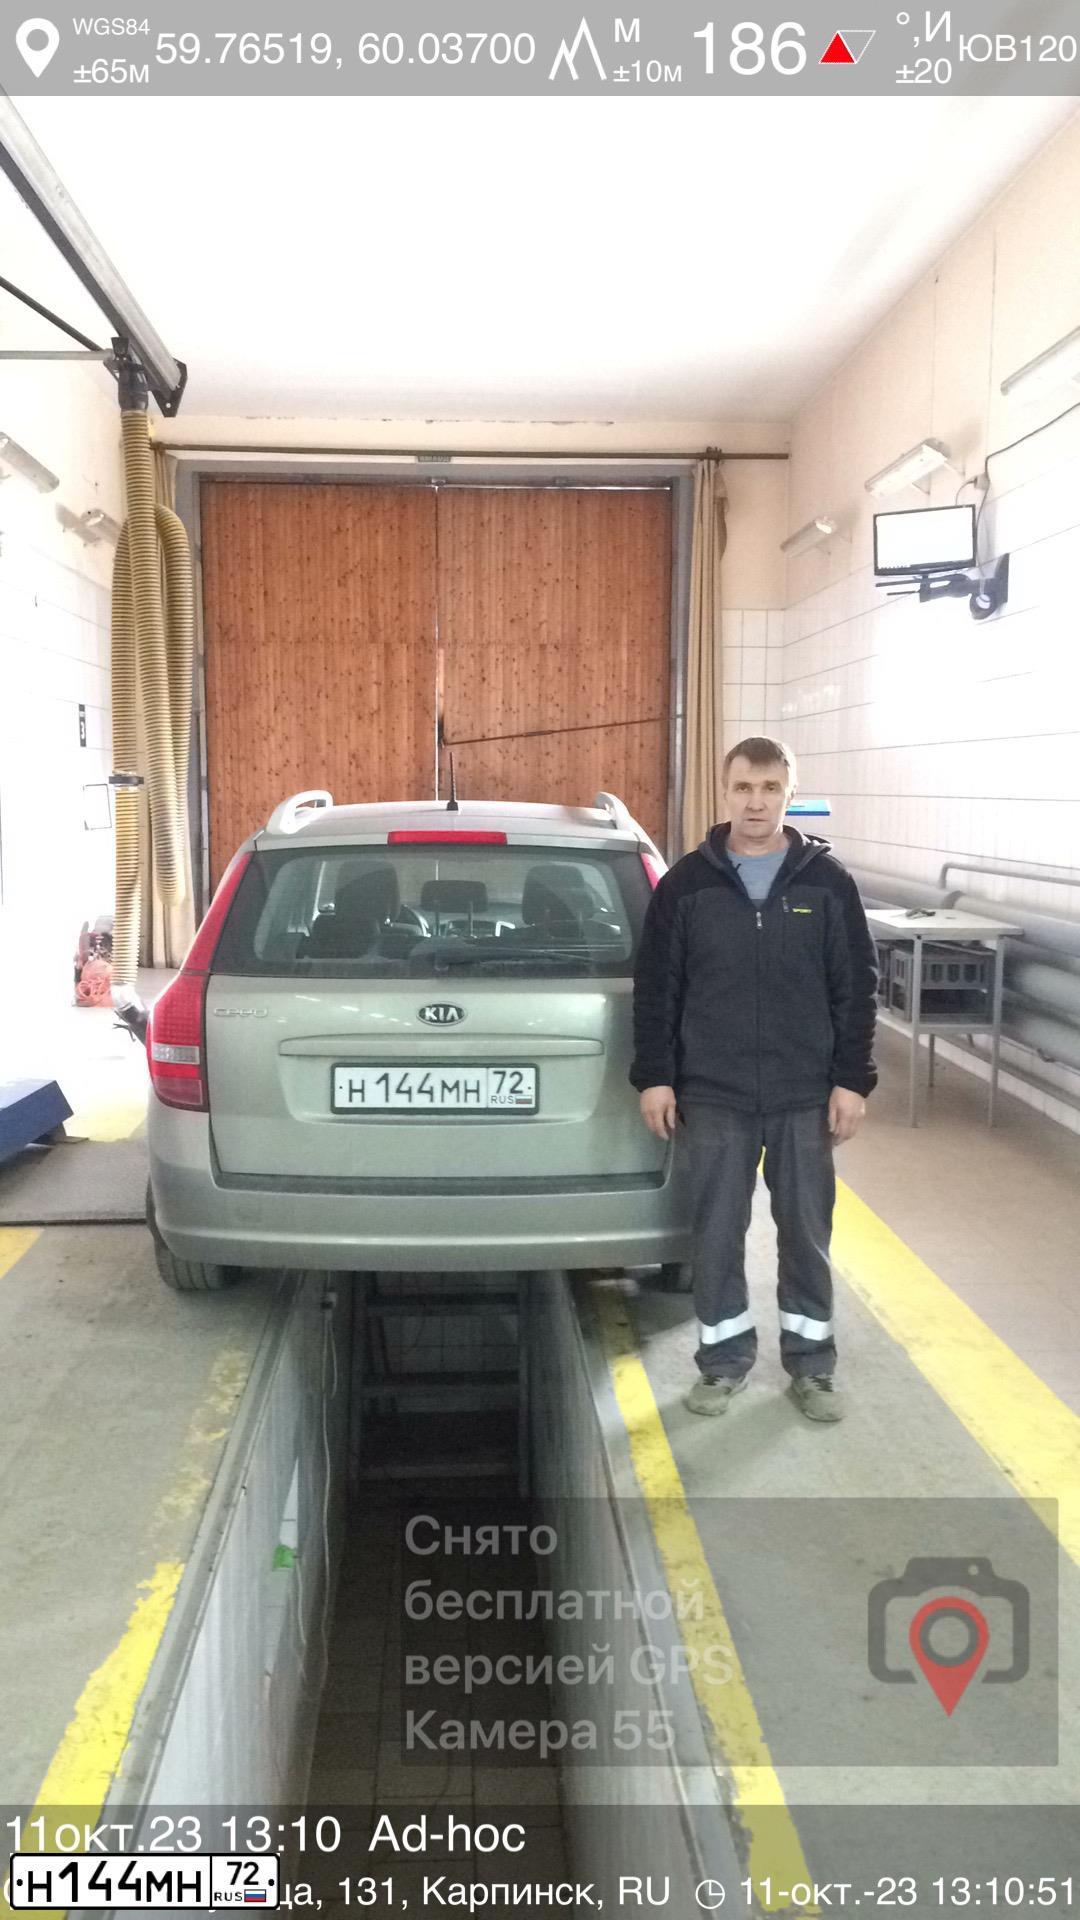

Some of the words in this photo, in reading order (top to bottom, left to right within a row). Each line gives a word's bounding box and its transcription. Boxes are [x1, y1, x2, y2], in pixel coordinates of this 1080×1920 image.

[425, 1007, 459, 1021] KIA
[494, 1071, 522, 1094] 72
[490, 1095, 514, 1105] RUS
